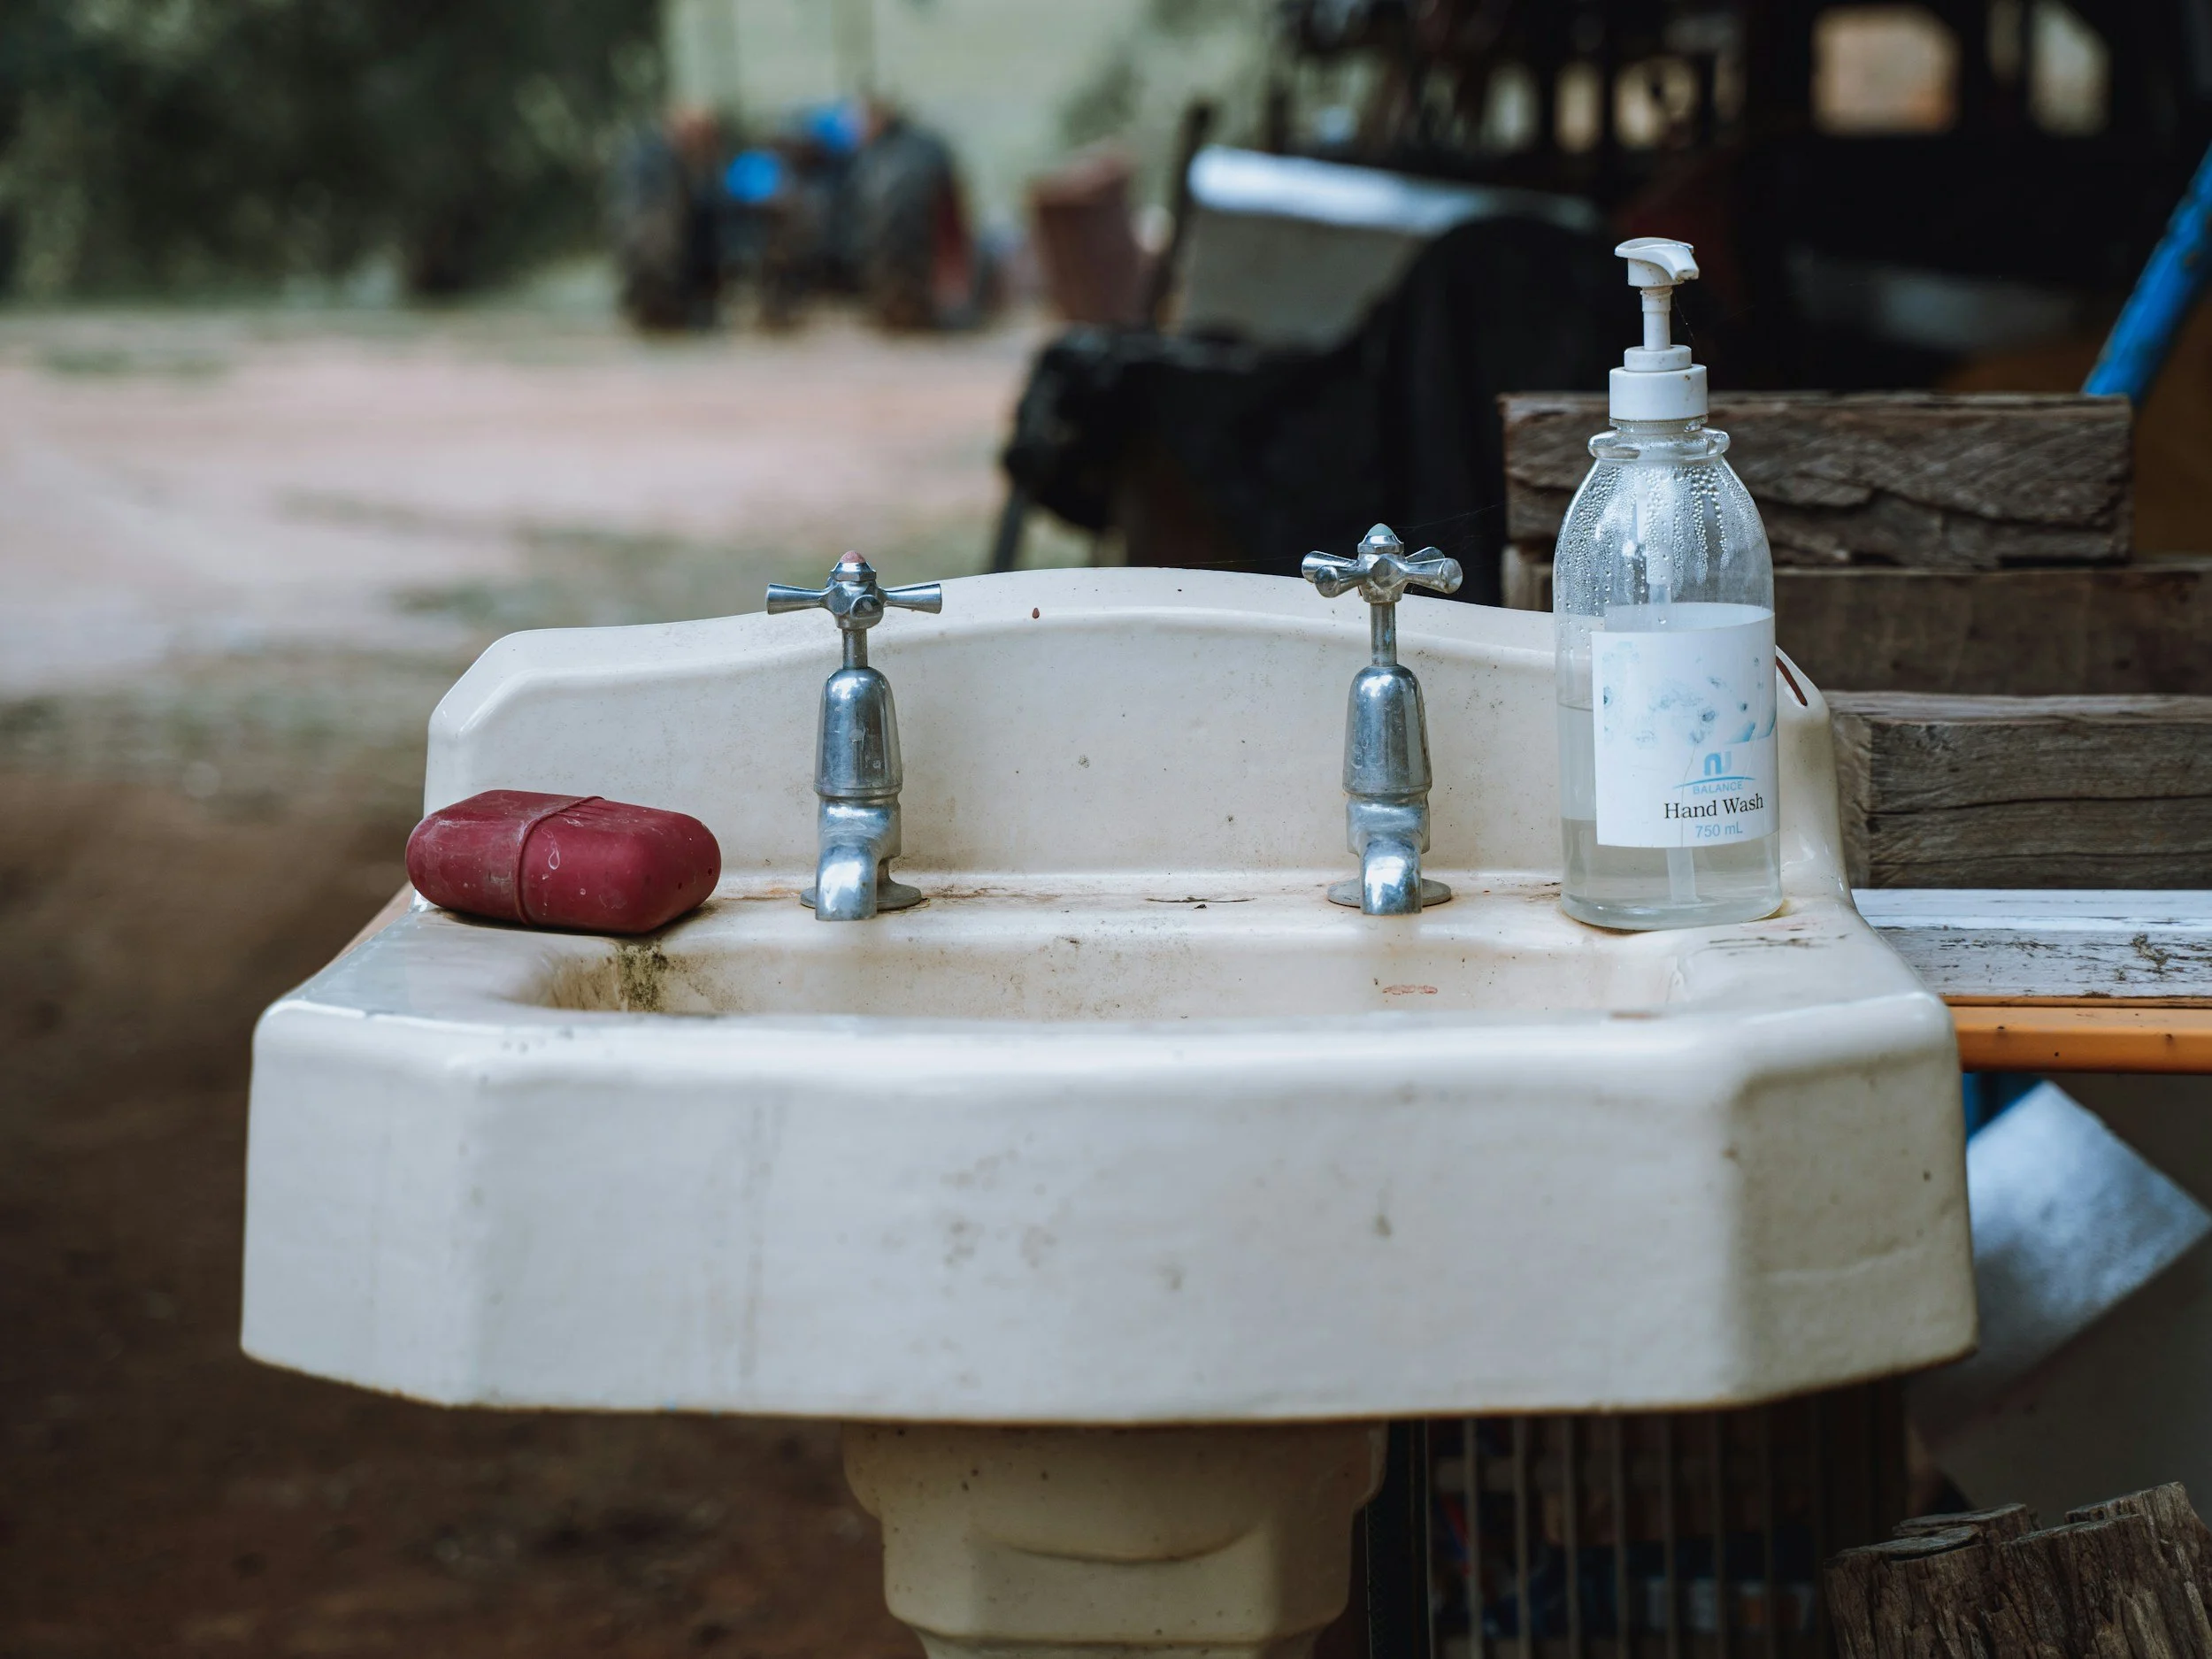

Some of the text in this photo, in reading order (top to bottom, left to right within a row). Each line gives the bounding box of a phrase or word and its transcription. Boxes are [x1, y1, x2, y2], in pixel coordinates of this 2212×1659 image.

[1693, 780, 1743, 795] BALANCE
[1664, 793, 1763, 818] Hand Wash
[1695, 821, 1743, 838] 750 mL
